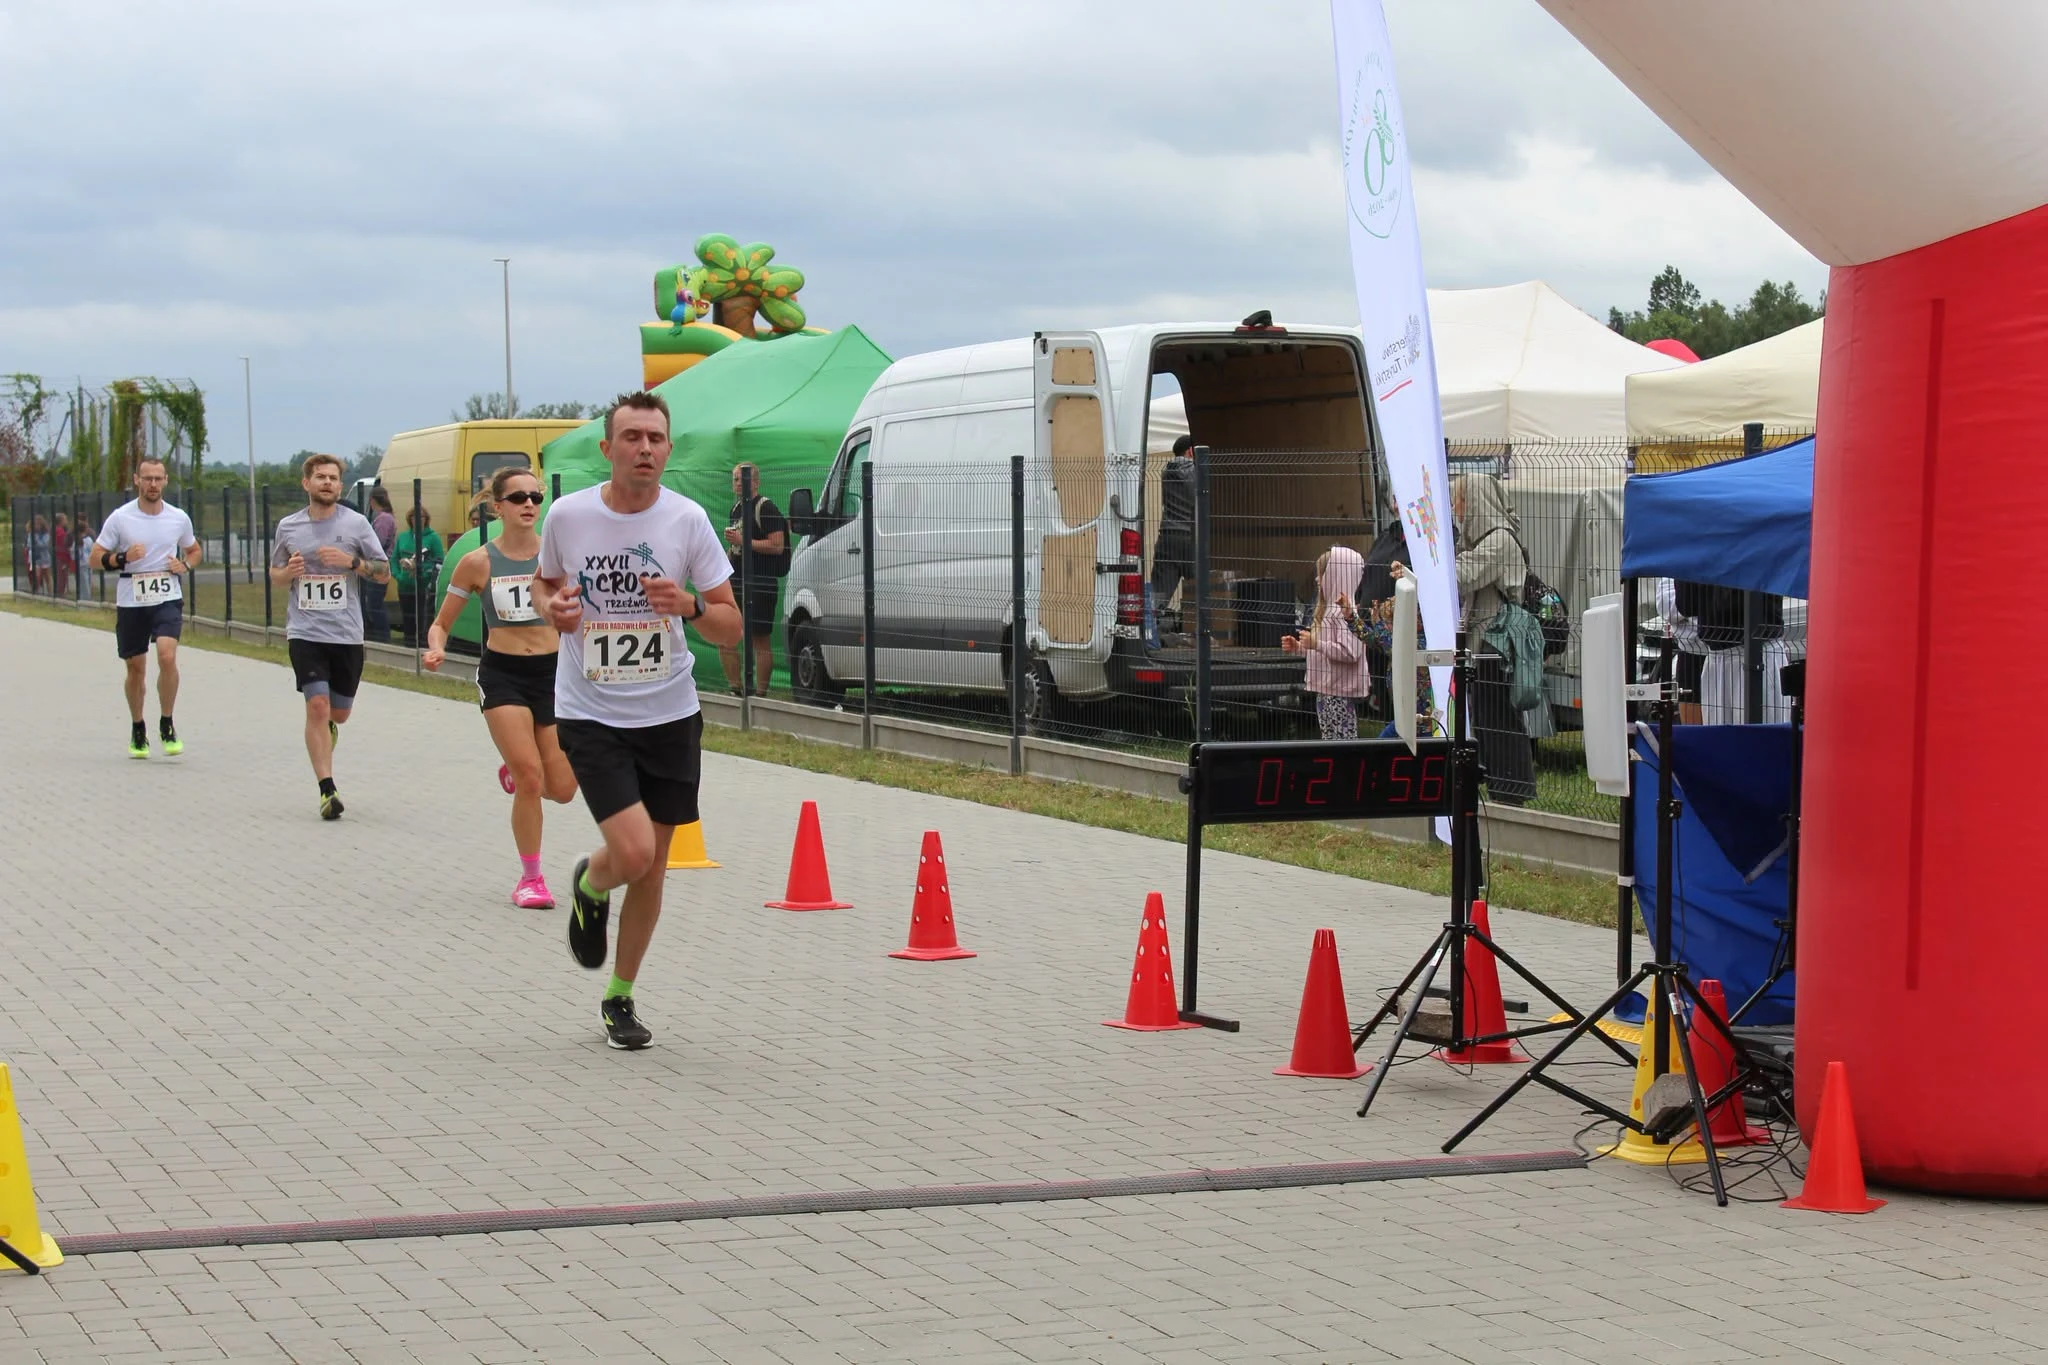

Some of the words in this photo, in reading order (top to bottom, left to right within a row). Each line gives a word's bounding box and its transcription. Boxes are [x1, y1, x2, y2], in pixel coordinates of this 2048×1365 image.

[585, 555, 630, 571] XXVII
[137, 578, 171, 594] 145
[304, 582, 342, 600] 116
[595, 571, 661, 597] CROS
[594, 632, 664, 667] 124
[1254, 757, 1446, 805] 0:21:56
